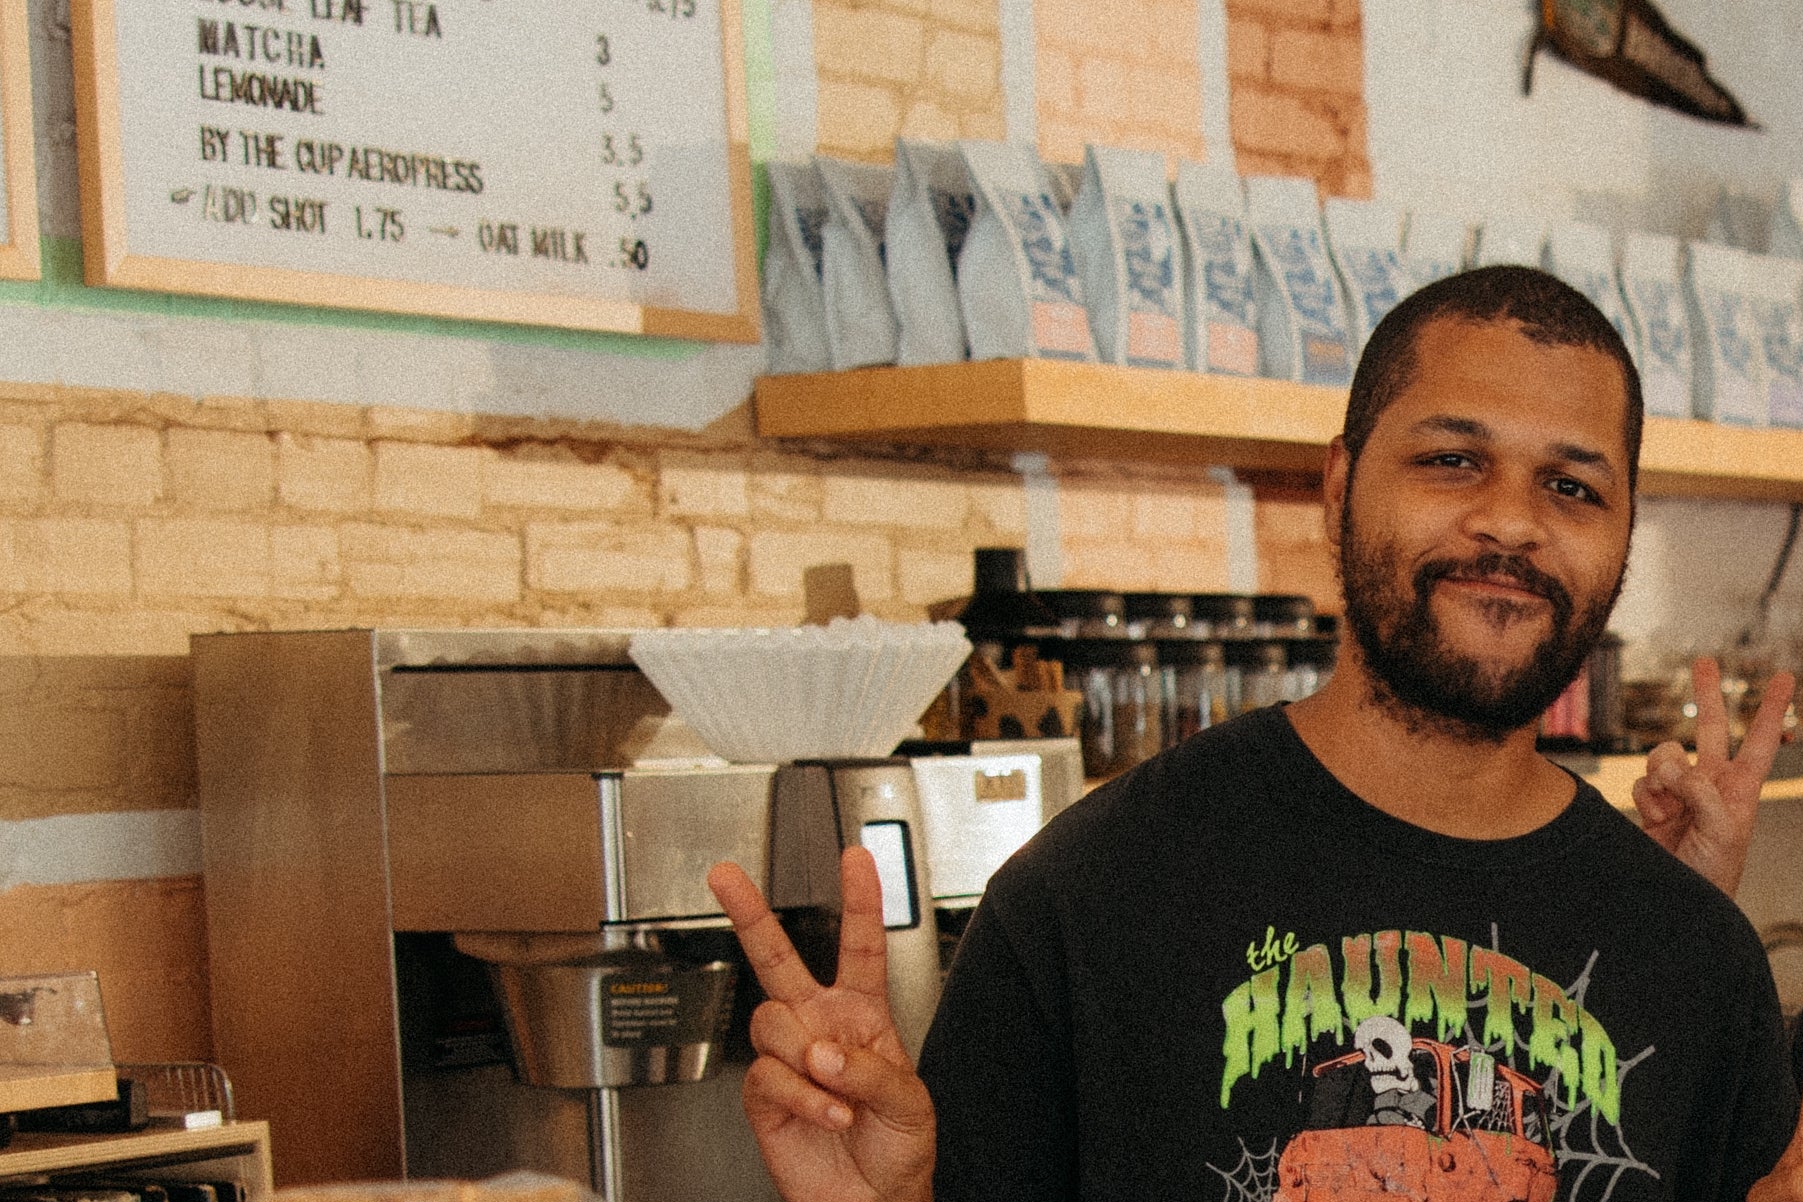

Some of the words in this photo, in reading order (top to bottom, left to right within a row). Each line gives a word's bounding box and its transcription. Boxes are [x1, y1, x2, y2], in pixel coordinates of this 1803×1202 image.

[197, 18, 325, 68] MATCHA
[393, 0, 442, 39] TEA
[597, 34, 610, 66] 3
[200, 63, 325, 115] LEMONADE
[200, 125, 228, 162] BY
[240, 129, 285, 170] THE
[297, 138, 342, 175] CUP
[348, 146, 483, 194] AEROPRESS
[203, 184, 257, 224] ADD
[270, 195, 327, 234] SHOT
[356, 206, 404, 242] 1.75
[478, 218, 518, 255] OAT
[530, 224, 588, 264] MILK
[609, 235, 649, 270] .50
[1246, 925, 1299, 972] the
[1220, 929, 1621, 1126] HAUNTED
